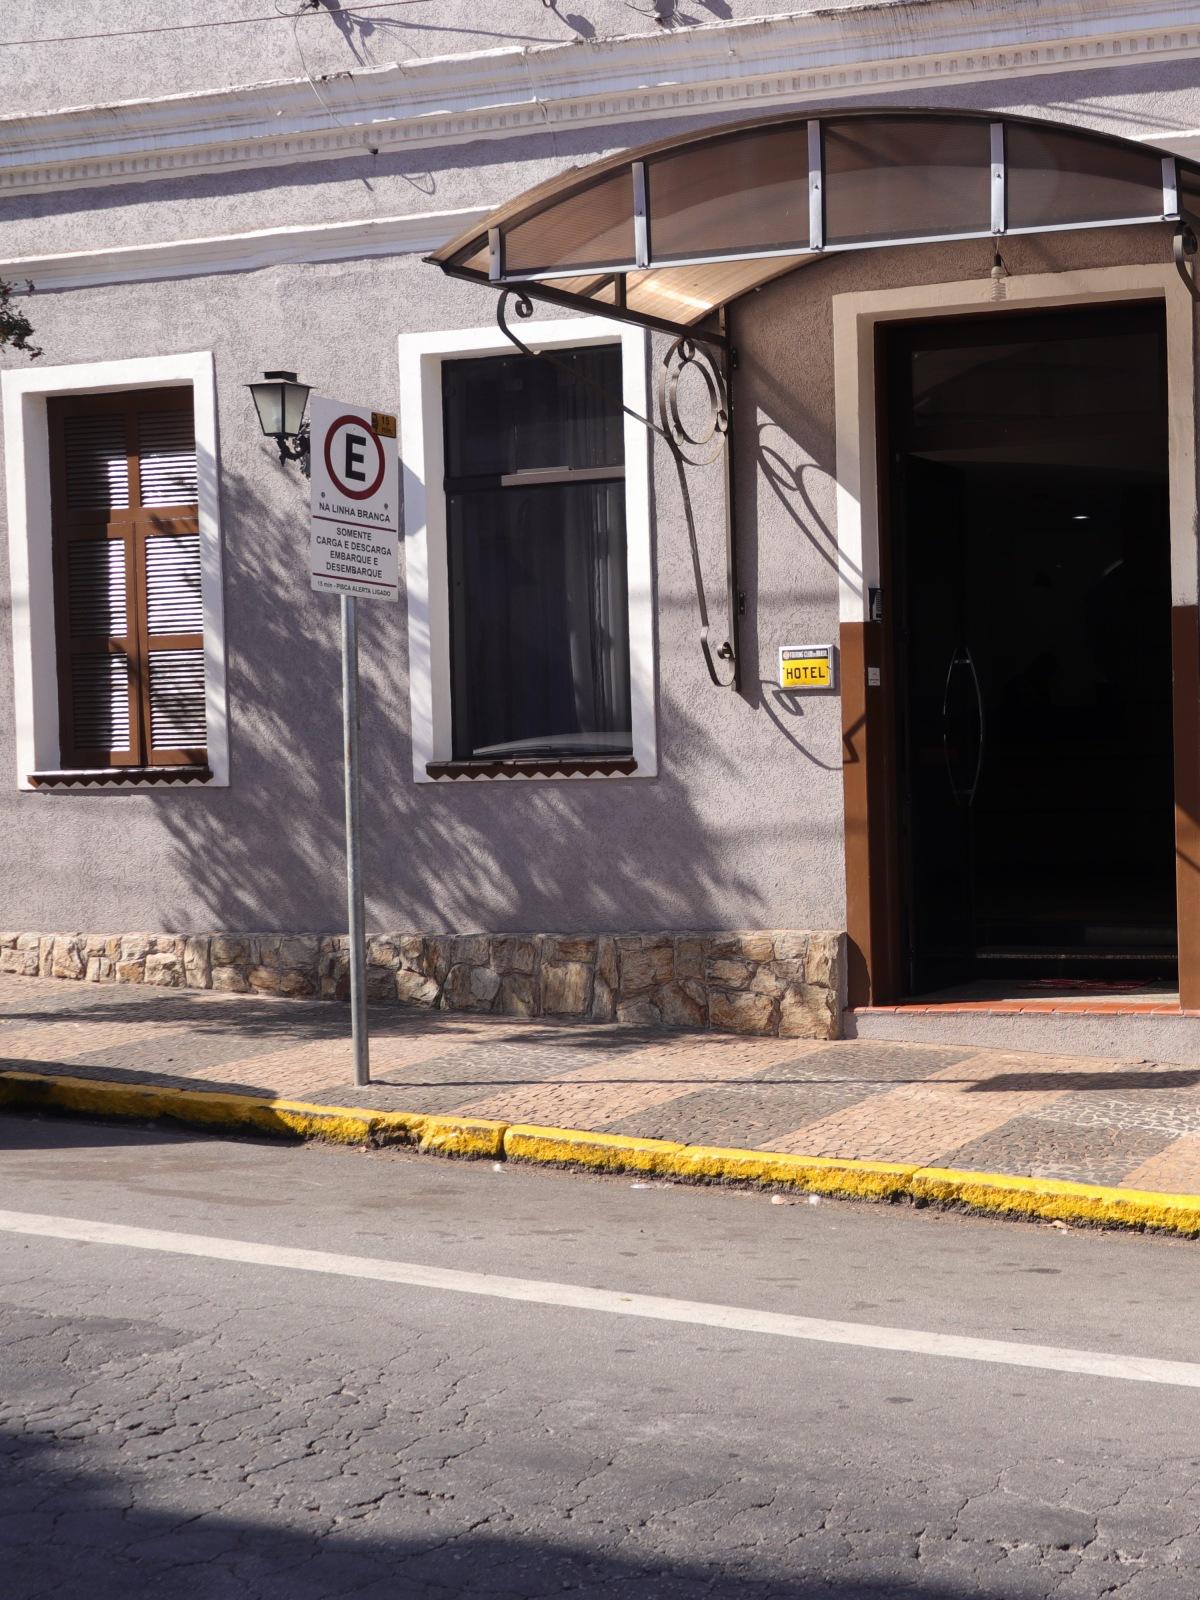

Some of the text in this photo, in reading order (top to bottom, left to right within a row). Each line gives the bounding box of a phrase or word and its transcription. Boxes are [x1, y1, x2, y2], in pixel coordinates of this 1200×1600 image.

[346, 433, 366, 482] E
[319, 502, 390, 522] NA LINHA BRANCA
[336, 527, 372, 541] SOMENTE
[316, 535, 392, 556] CARGA E DESCARGA
[330, 550, 379, 566] EMBARQUE E
[326, 561, 383, 579] DESEMBARQUE
[336, 583, 351, 591] PISCA
[352, 585, 371, 594] ALERTA
[372, 588, 391, 597] LIGADO
[787, 667, 825, 679] HOTEL
